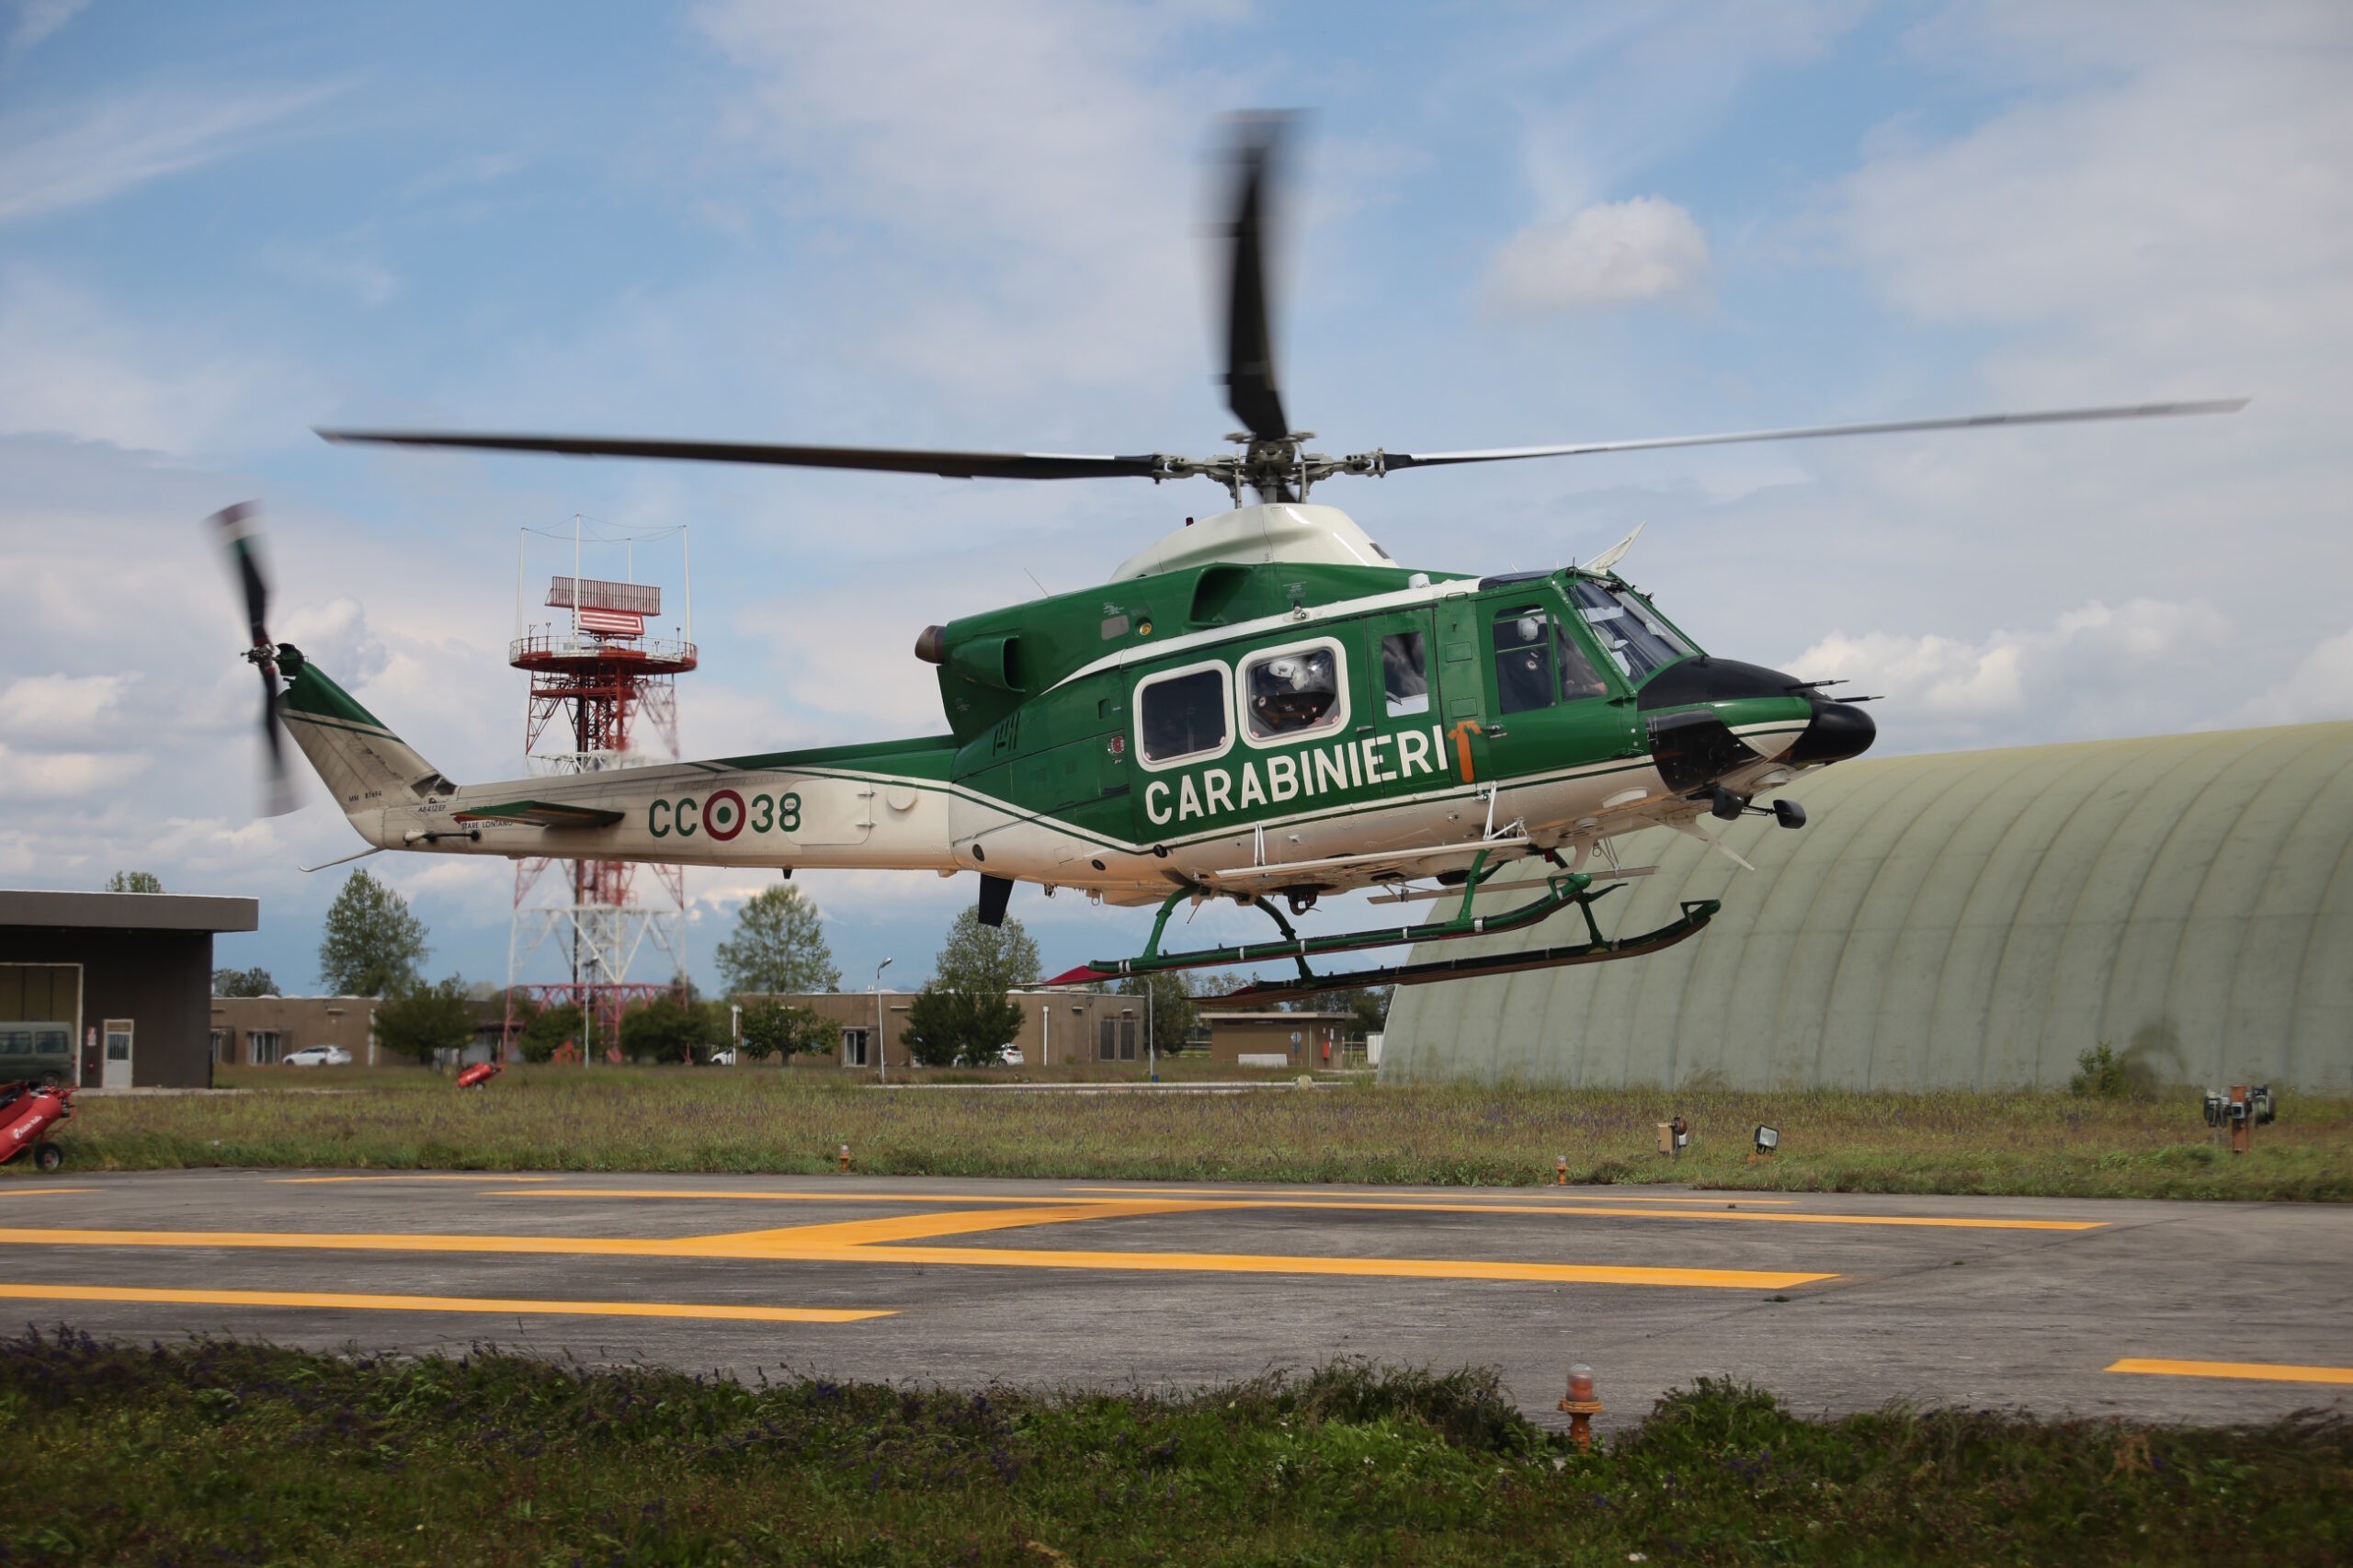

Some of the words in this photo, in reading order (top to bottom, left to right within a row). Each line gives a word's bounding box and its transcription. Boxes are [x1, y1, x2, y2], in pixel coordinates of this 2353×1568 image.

[1145, 725, 1448, 824] CARABINIERI
[460, 822, 479, 830] STARE
[649, 798, 698, 837] CC
[751, 792, 801, 833] 38
